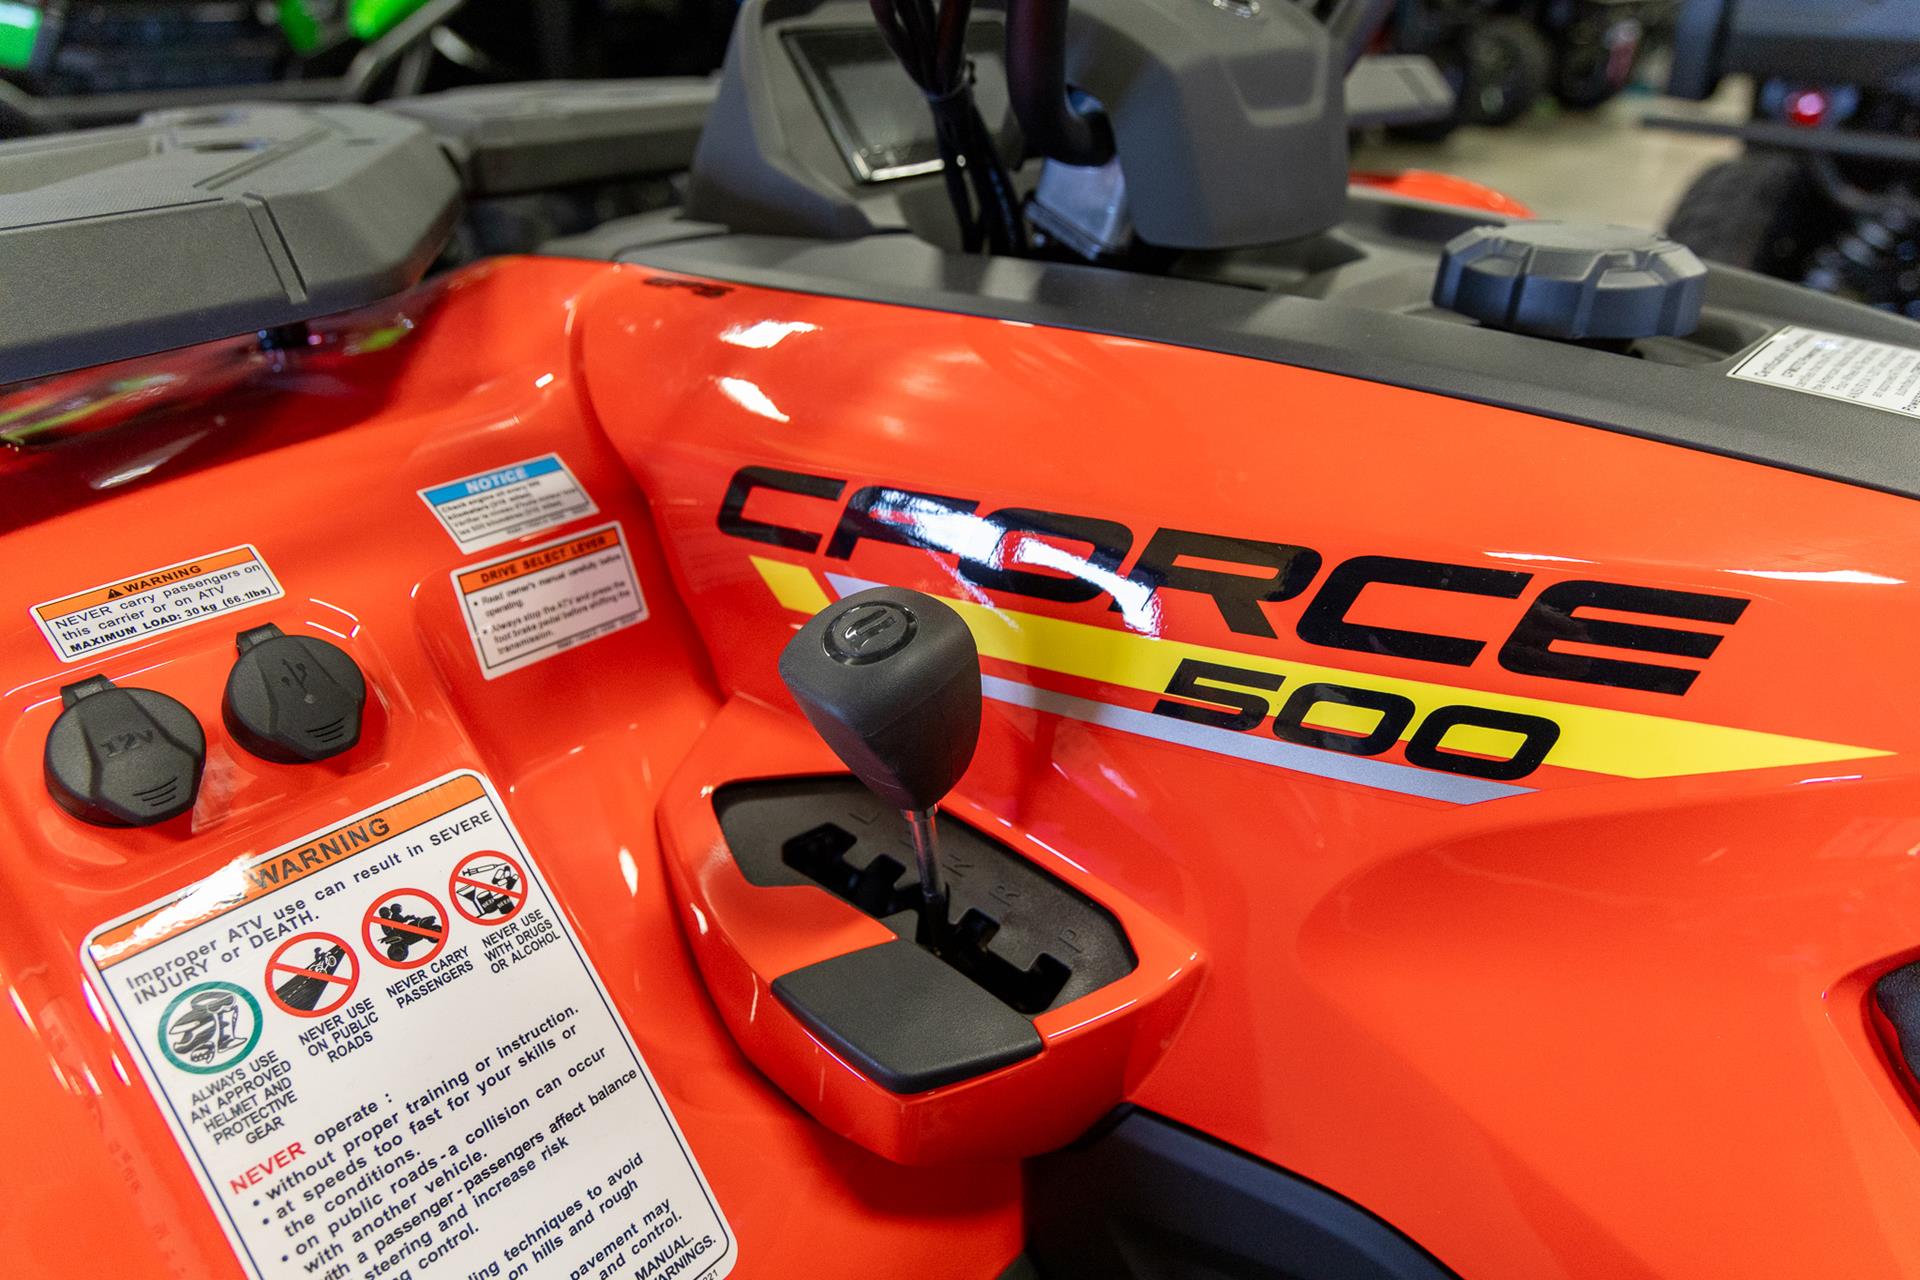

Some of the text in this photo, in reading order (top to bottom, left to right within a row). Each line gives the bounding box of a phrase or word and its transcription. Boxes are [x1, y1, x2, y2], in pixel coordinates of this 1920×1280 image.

[465, 467, 528, 494] NOTICE
[123, 565, 201, 592] WARNING
[479, 535, 606, 583] DRIVE SELECT LEVER
[716, 464, 1751, 697] CFORCE
[55, 565, 260, 629] NEVER carry passengers on
[62, 585, 224, 640] this carrier or on ATV
[70, 626, 137, 652] MAXIMUM
[142, 614, 182, 629] LOAD:
[101, 728, 154, 758] 12V
[1153, 657, 1560, 781] 500
[250, 817, 391, 889] WARNING
[126, 810, 492, 989] Improper ATV use can result in SEVERE
[481, 909, 543, 948] NEVER USE
[484, 919, 553, 962] WITH DRUGS
[491, 930, 561, 974] OR ALCOHOL
[134, 910, 319, 1004] INJURY or DEATH.
[386, 946, 468, 998] NEVER CARRY
[396, 960, 473, 1009] PASSENGERS
[298, 998, 374, 1045] NEVER USE
[308, 1011, 378, 1056] ON PUBLIC
[327, 1031, 373, 1063] ROADS
[191, 1060, 291, 1123] AN APPROVED
[192, 1050, 279, 1106] ALWAYS USE
[203, 1077, 292, 1132] HELMET AND
[266, 1007, 578, 1200] without proper training or instruction.
[213, 1090, 298, 1145] PROTECTIVE
[246, 1116, 285, 1144] GEAR
[276, 1025, 576, 1219] at speeds too fast for your skills or
[230, 1142, 306, 1194] NEVER
[314, 1102, 378, 1145] operate
[296, 1235, 319, 1255] on
[328, 1194, 383, 1238] public
[465, 1098, 530, 1144] collision
[536, 1077, 562, 1098] can
[568, 1047, 605, 1078] occur
[357, 1252, 368, 1264] a
[549, 1102, 586, 1133] affect
[588, 1070, 637, 1106] balance
[285, 1150, 420, 1237] the conditions.
[304, 1152, 487, 1273] with another vehicle.
[364, 1137, 569, 1280] steering and increase risk
[504, 1200, 583, 1261] techniques
[587, 1186, 602, 1200] to
[607, 1152, 643, 1186] avoid
[418, 1222, 479, 1269] control.
[509, 1180, 638, 1280] on hills and rough
[570, 1199, 670, 1280] pavement may
[599, 1211, 682, 1280] and control.
[634, 1235, 694, 1280] MANUAL.
